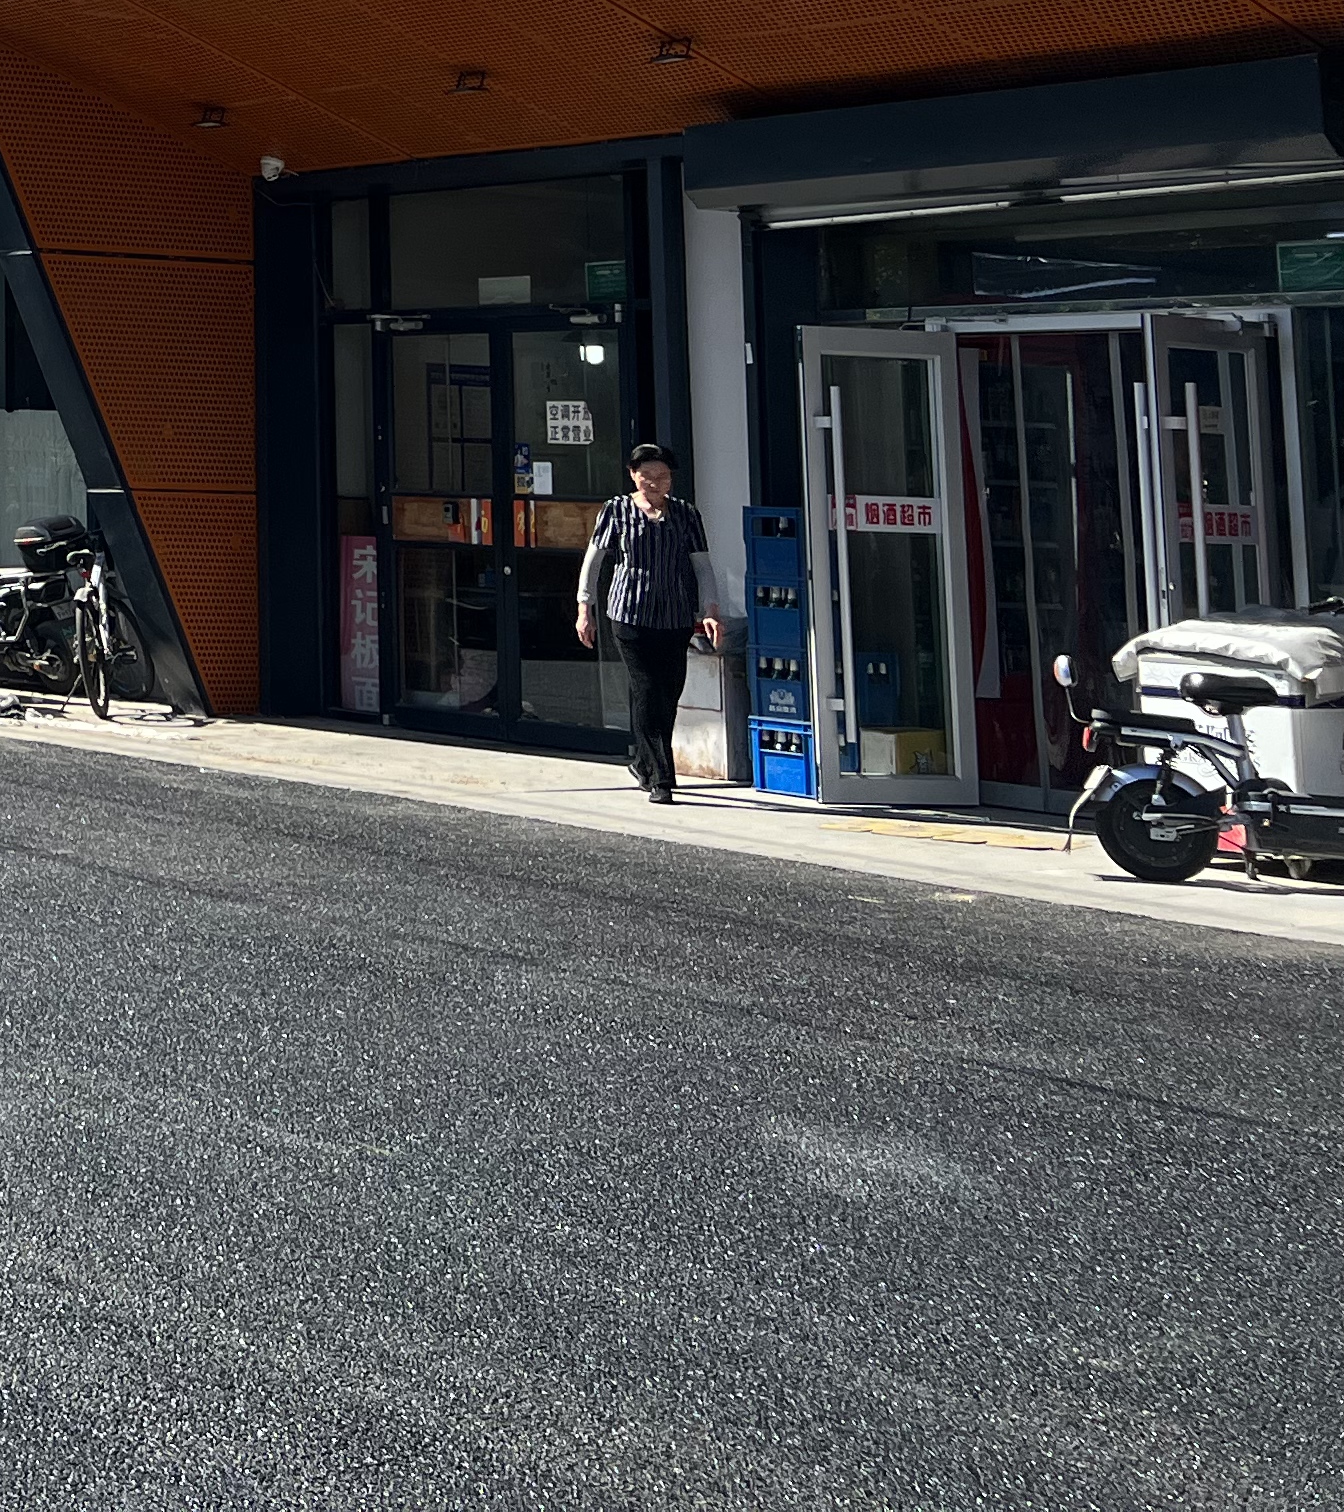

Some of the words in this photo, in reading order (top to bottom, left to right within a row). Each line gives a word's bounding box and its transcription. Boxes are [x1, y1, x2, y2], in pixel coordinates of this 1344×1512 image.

[549, 426, 592, 442] 正常营业
[865, 502, 932, 526] 烟酒超市
